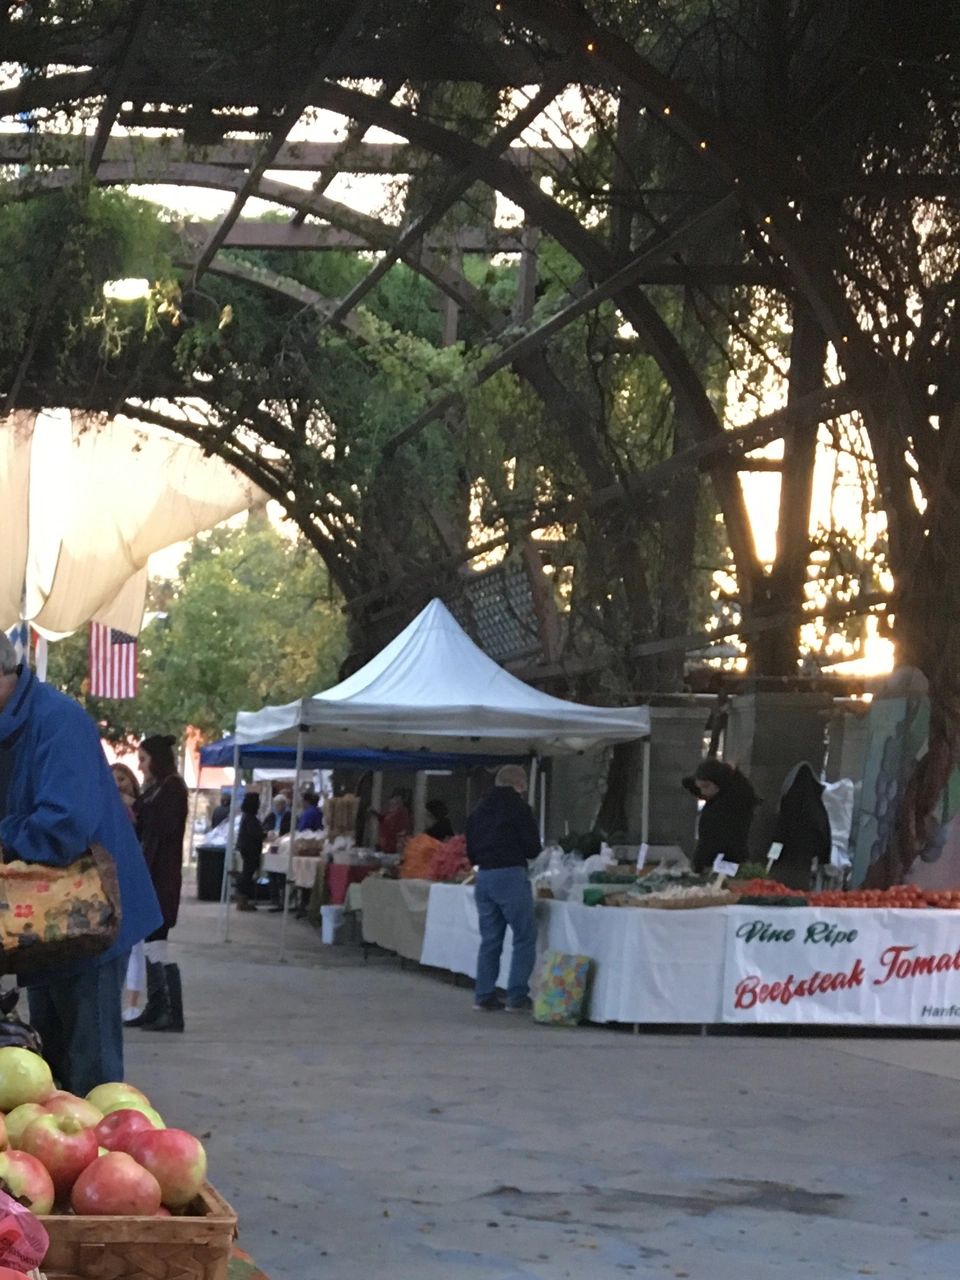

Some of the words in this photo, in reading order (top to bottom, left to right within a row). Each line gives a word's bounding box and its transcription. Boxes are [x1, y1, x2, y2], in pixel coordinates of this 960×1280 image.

[736, 920, 796, 944] Vine
[804, 921, 859, 947] Ripe
[734, 958, 866, 1010] Beefsteak
